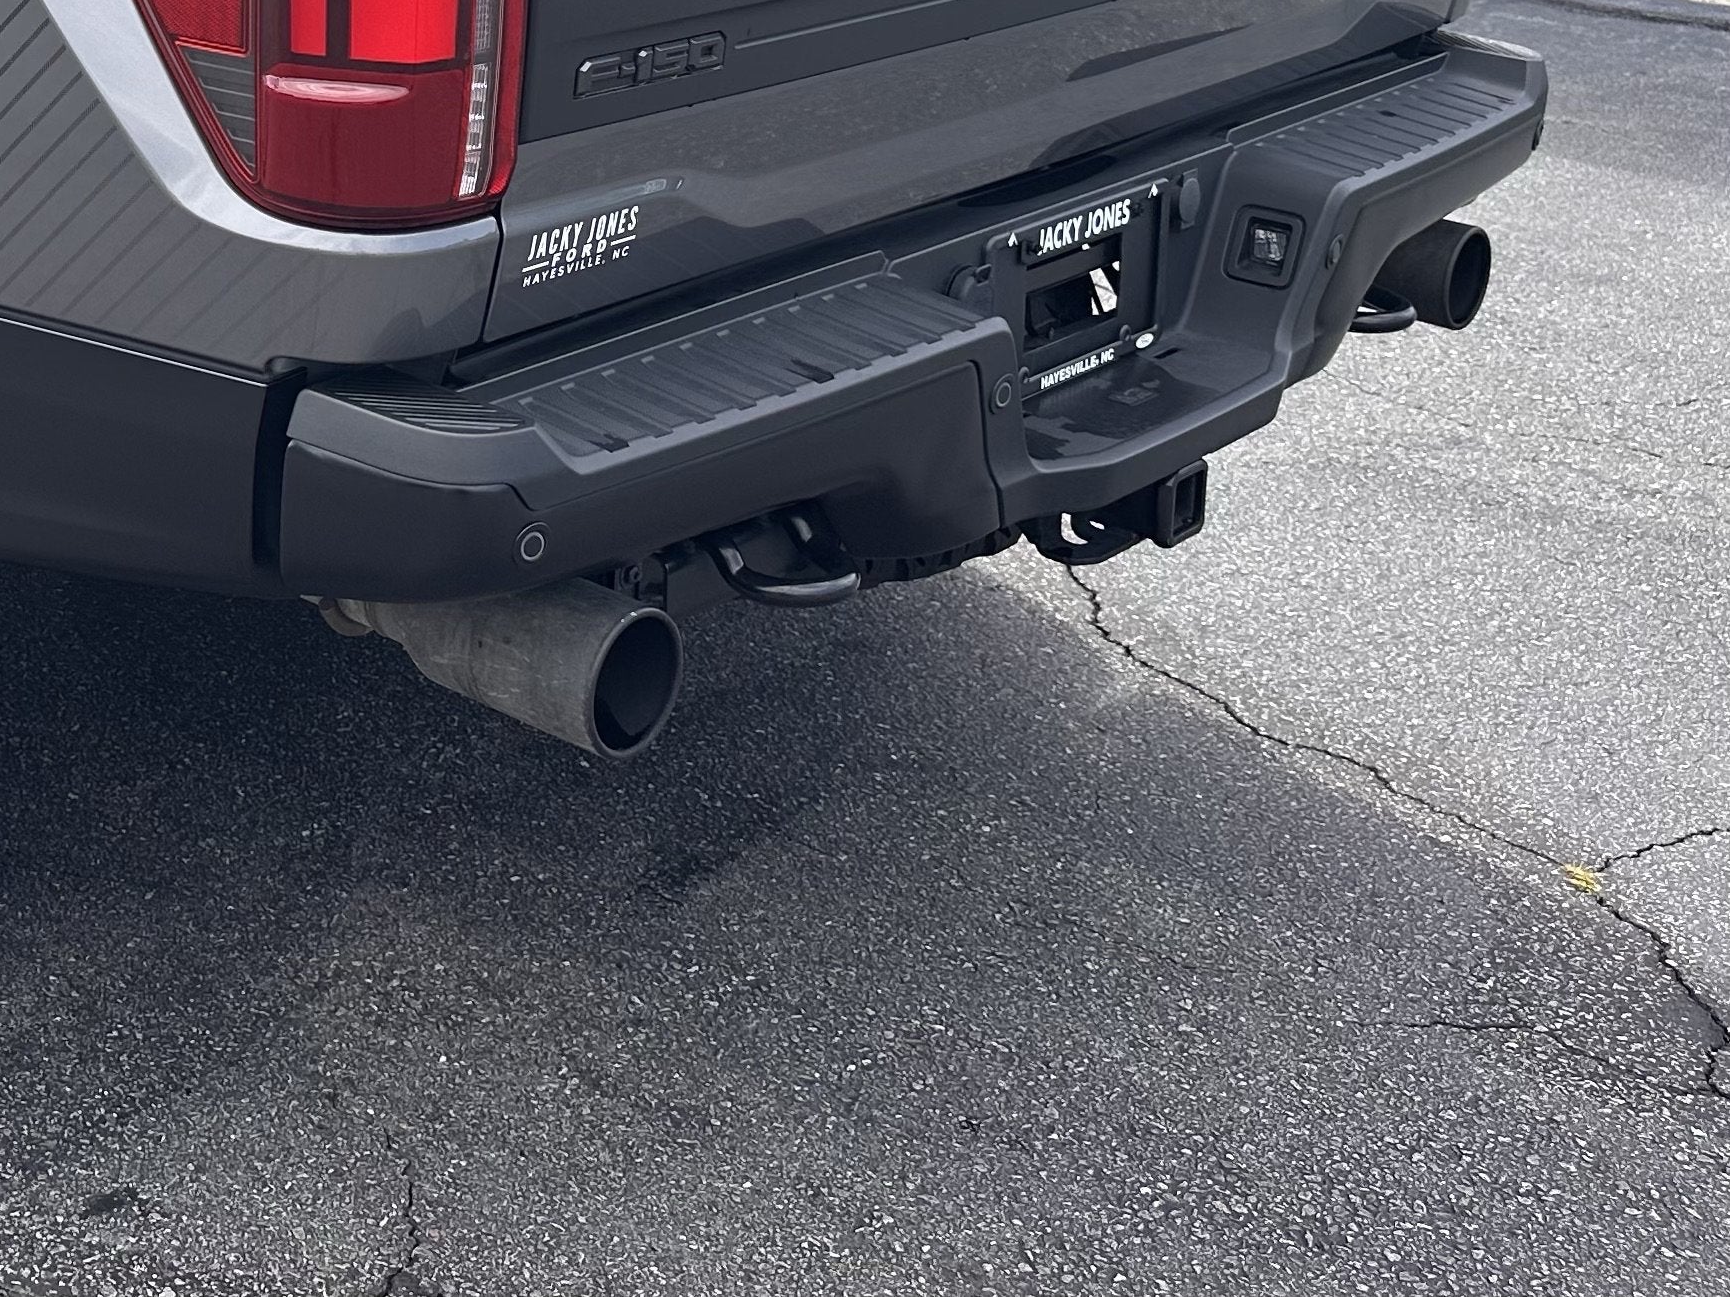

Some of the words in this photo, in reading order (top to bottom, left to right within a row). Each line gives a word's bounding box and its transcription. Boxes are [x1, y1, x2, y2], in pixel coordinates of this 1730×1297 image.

[573, 30, 727, 99] F-150
[527, 221, 584, 262] JACKY
[586, 205, 639, 244] JONES
[1037, 215, 1083, 256] JACKY
[1085, 198, 1131, 239] JONES
[551, 239, 607, 268] FORD
[612, 245, 630, 261] NC
[1100, 348, 1115, 366] NC
